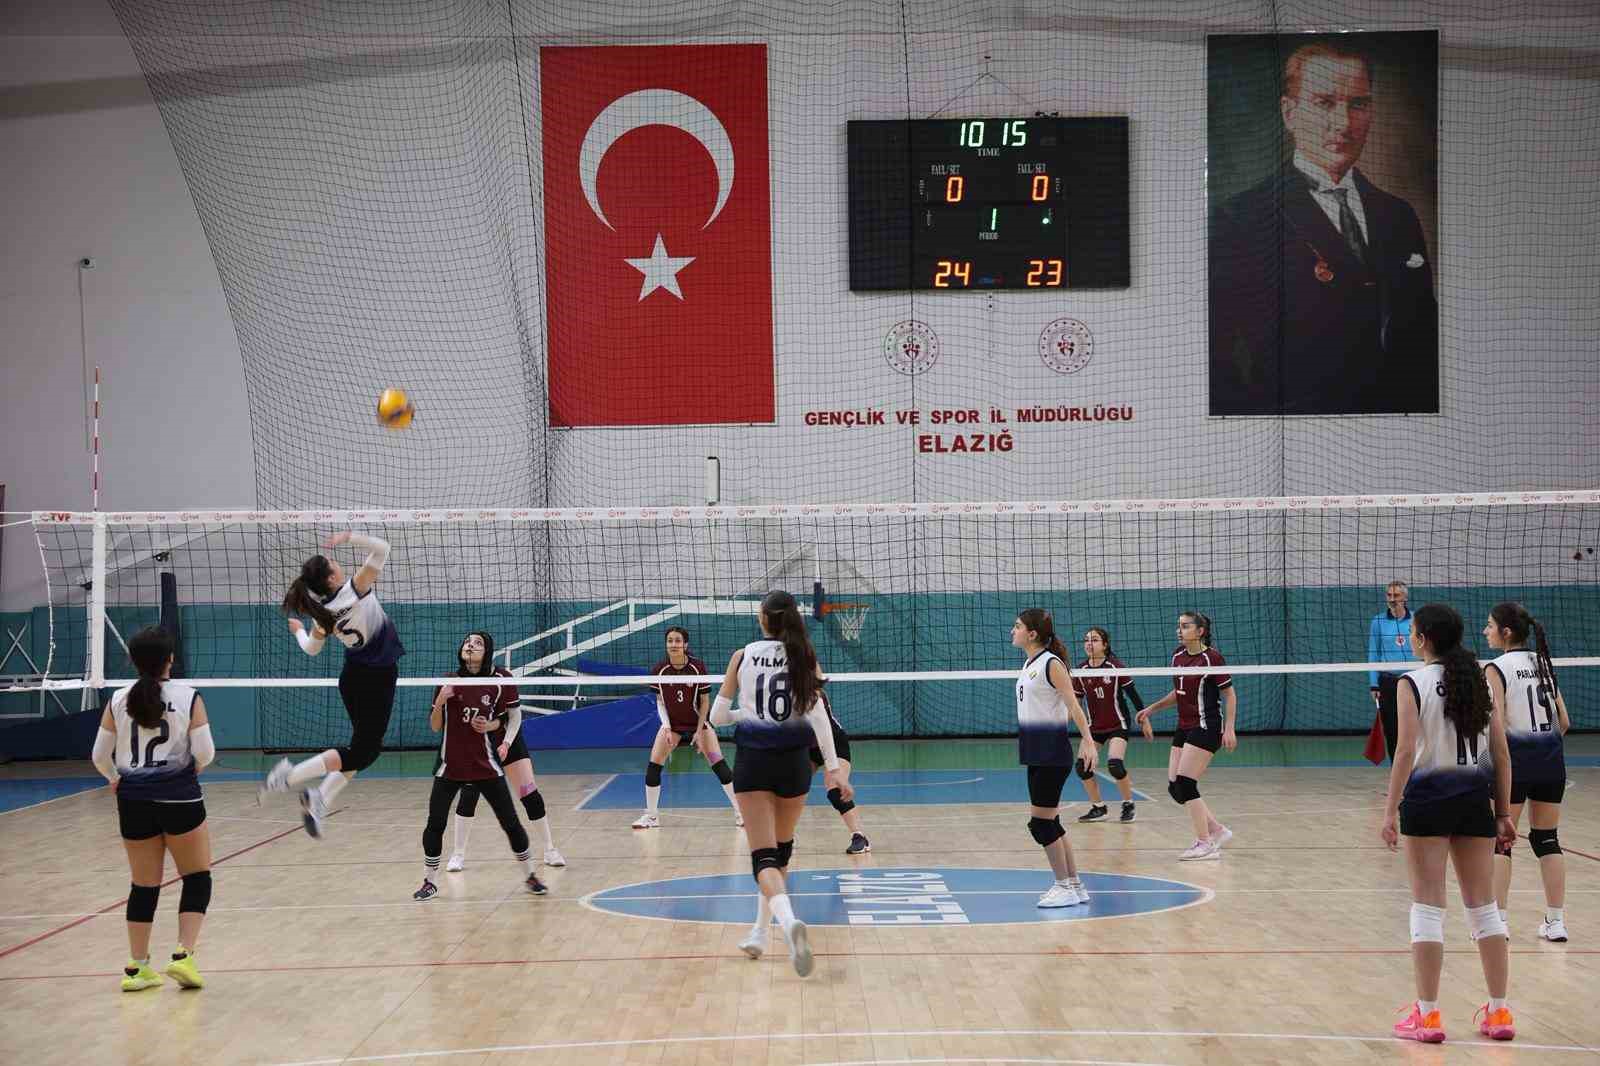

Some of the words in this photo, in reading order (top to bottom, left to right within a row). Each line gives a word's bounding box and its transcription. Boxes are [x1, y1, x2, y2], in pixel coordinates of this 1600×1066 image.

[960, 122, 984, 147] 10
[1002, 120, 1026, 146] 15
[978, 148, 1000, 156] TIME
[946, 176, 963, 202] 0
[1032, 175, 1048, 201] 0
[991, 208, 997, 230] 1
[934, 261, 970, 287] 24
[1027, 260, 1062, 286] 23
[805, 408, 884, 428] GENÇLİK
[896, 411, 920, 425] VE
[930, 410, 980, 424] SPOR
[919, 430, 1013, 453] ELAZIĞ
[50, 513, 72, 522] TVF
[676, 690, 684, 703] 3
[756, 673, 792, 722] 18
[1094, 687, 1104, 699] 10
[130, 719, 169, 768] 12
